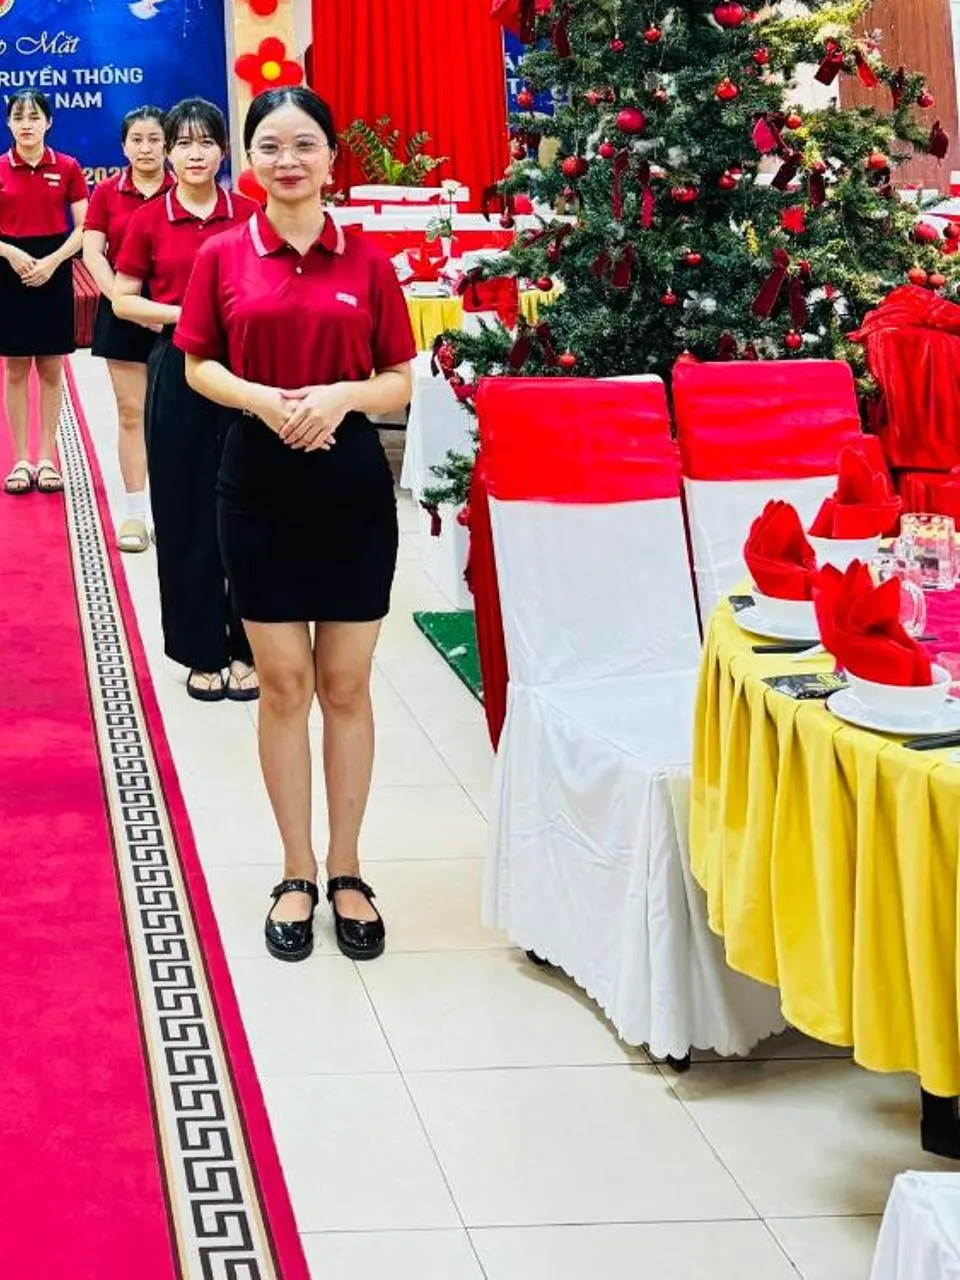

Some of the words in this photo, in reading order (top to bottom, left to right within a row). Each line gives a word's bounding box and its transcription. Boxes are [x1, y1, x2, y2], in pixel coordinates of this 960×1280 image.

[15, 31, 81, 58] Mặt
[72, 64, 144, 85] THỐNG
[55, 91, 103, 109] NAM
[83, 166, 126, 185] 202
